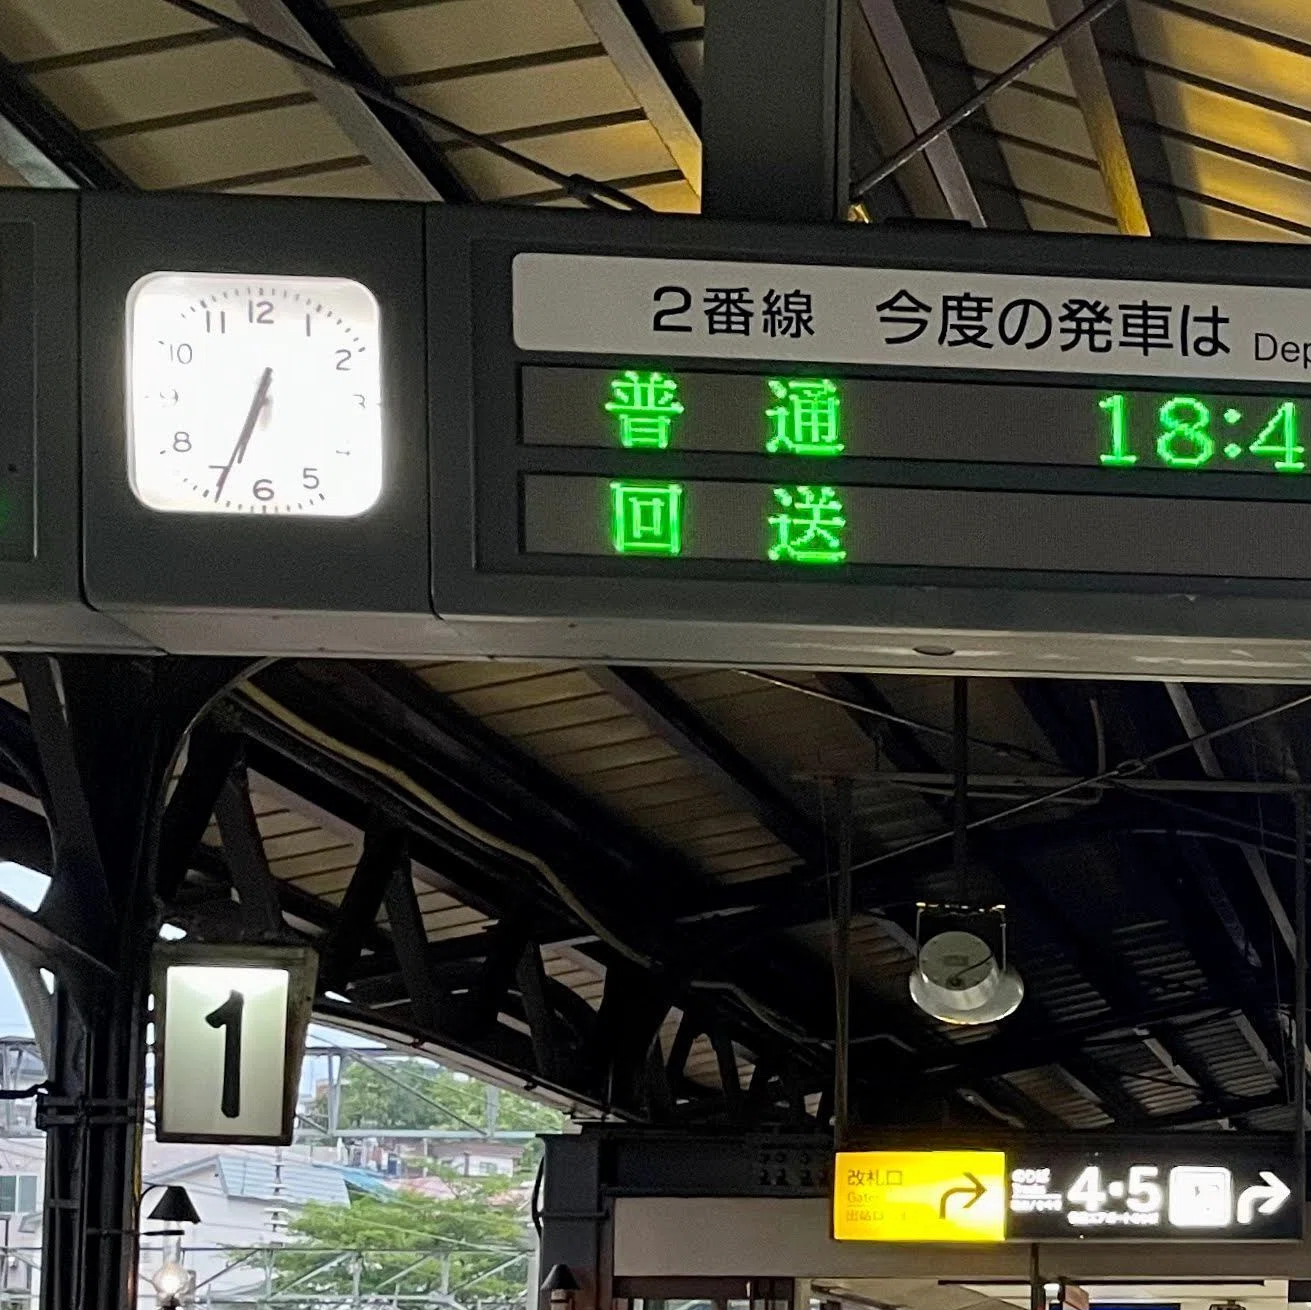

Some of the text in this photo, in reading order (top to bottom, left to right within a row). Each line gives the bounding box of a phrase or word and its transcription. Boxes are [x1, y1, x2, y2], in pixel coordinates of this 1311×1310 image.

[206, 310, 225, 334] 11
[248, 299, 274, 324] 12
[652, 286, 816, 340] 2番線
[875, 290, 1232, 359] 今度の発車は
[305, 313, 312, 337] 1
[169, 343, 193, 365] 10
[335, 348, 352, 371] 2
[605, 369, 845, 456] 普通
[172, 431, 193, 453] 8
[252, 478, 275, 501] 6
[302, 467, 320, 490] 5
[609, 481, 847, 564] 回送
[205, 988, 244, 1118] 1
[847, 1168, 903, 1186] 改札口
